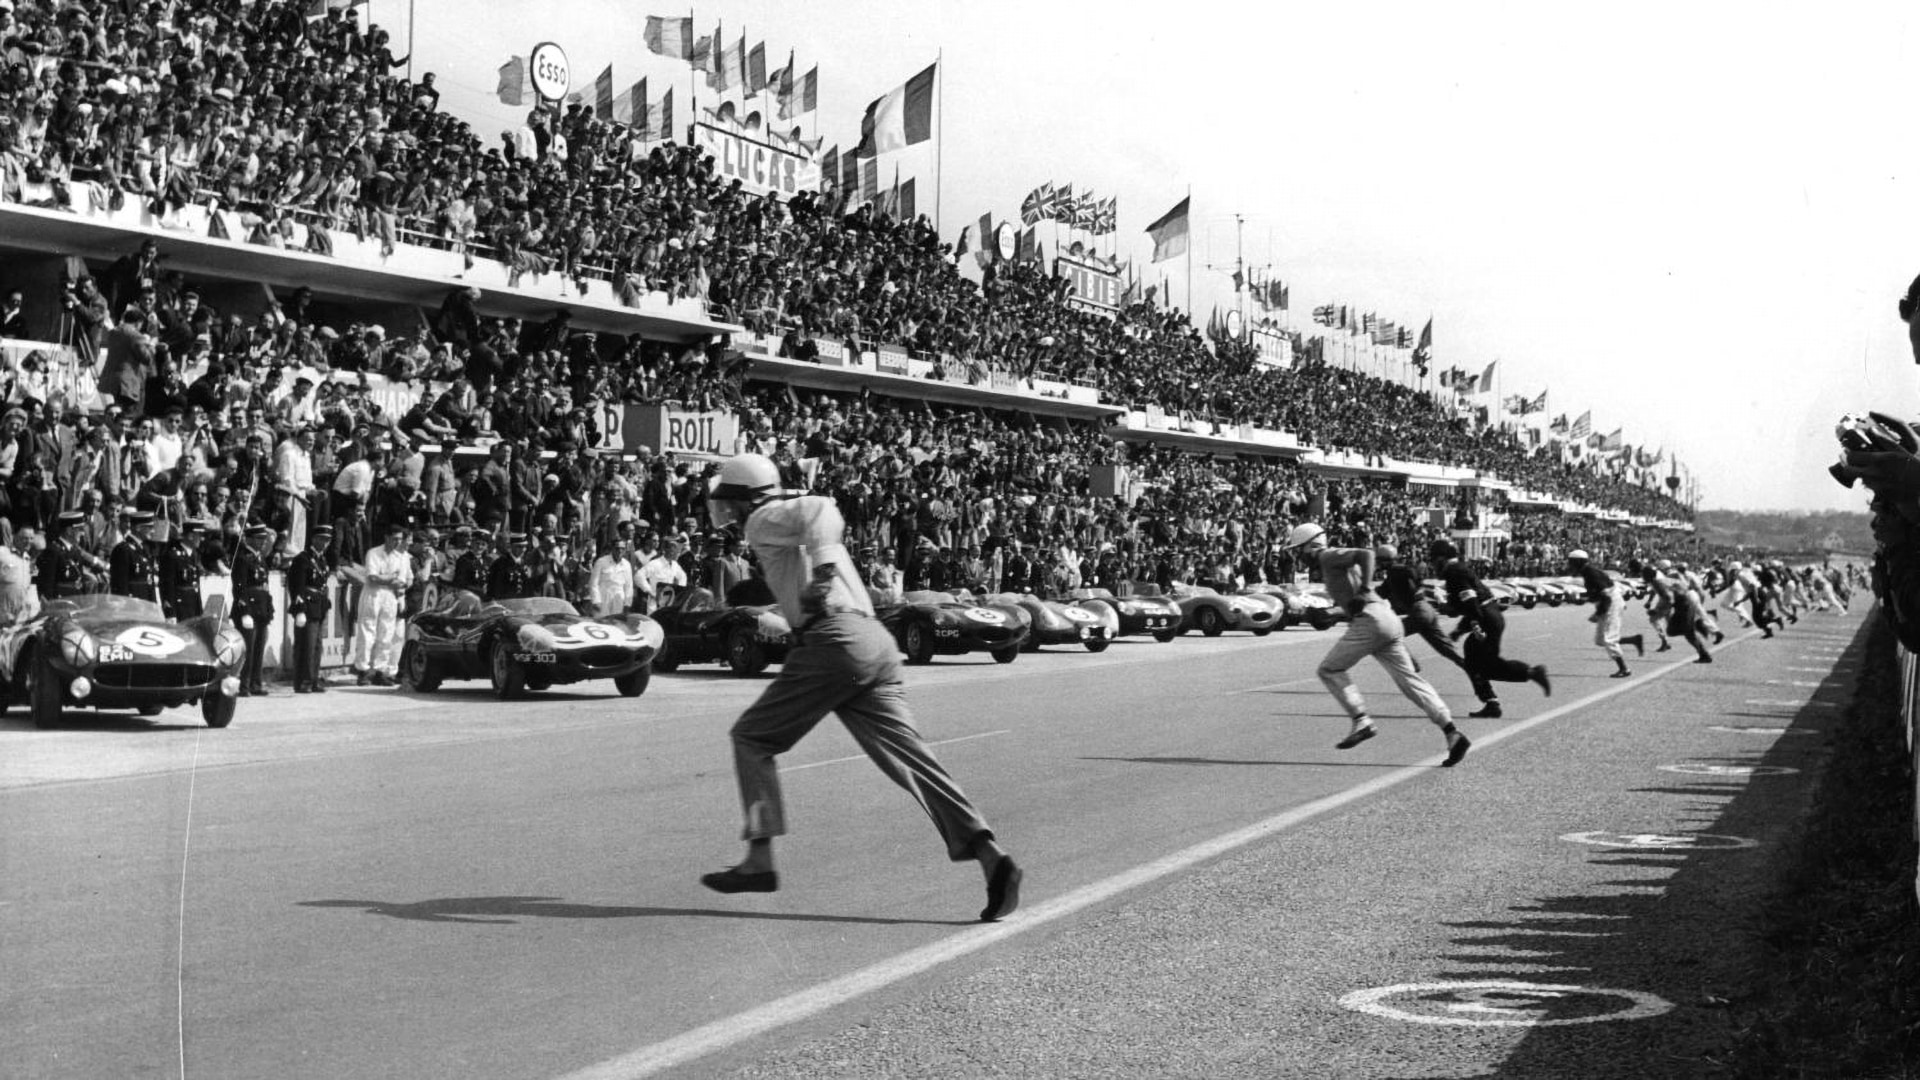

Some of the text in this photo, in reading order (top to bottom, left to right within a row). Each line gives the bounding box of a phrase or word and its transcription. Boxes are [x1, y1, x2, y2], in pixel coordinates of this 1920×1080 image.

[724, 138, 795, 193] LUCAS
[603, 406, 619, 447] P
[668, 417, 720, 454] ROIL
[136, 631, 163, 647] 5
[583, 625, 610, 640] 6
